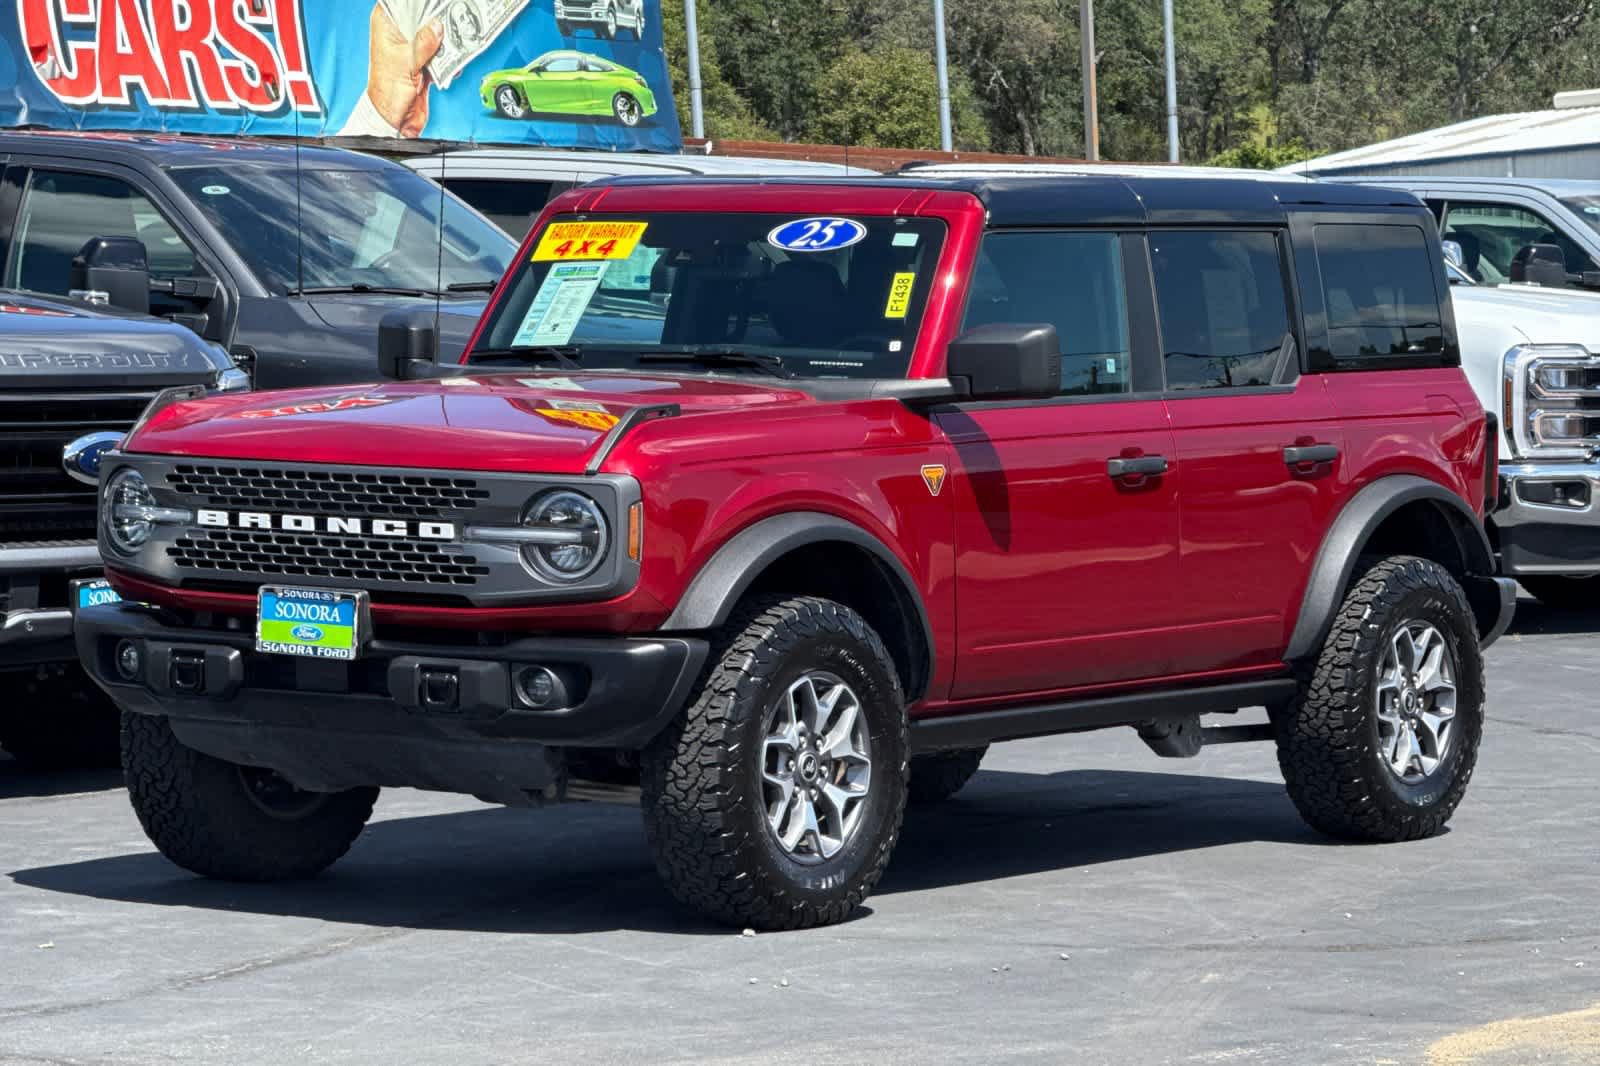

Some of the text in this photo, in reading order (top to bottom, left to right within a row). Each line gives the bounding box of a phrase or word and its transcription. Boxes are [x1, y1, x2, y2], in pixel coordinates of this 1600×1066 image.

[18, 0, 322, 112] CARS!
[550, 224, 640, 239] FACTORY WARRANTY
[787, 220, 846, 247] 25
[889, 277, 911, 312] F1438
[104, 352, 188, 368] DUTY
[197, 509, 455, 539] BRONCO
[284, 590, 320, 600] SONORA
[275, 602, 341, 623] SONORA
[263, 642, 348, 658] SONORA FORD
